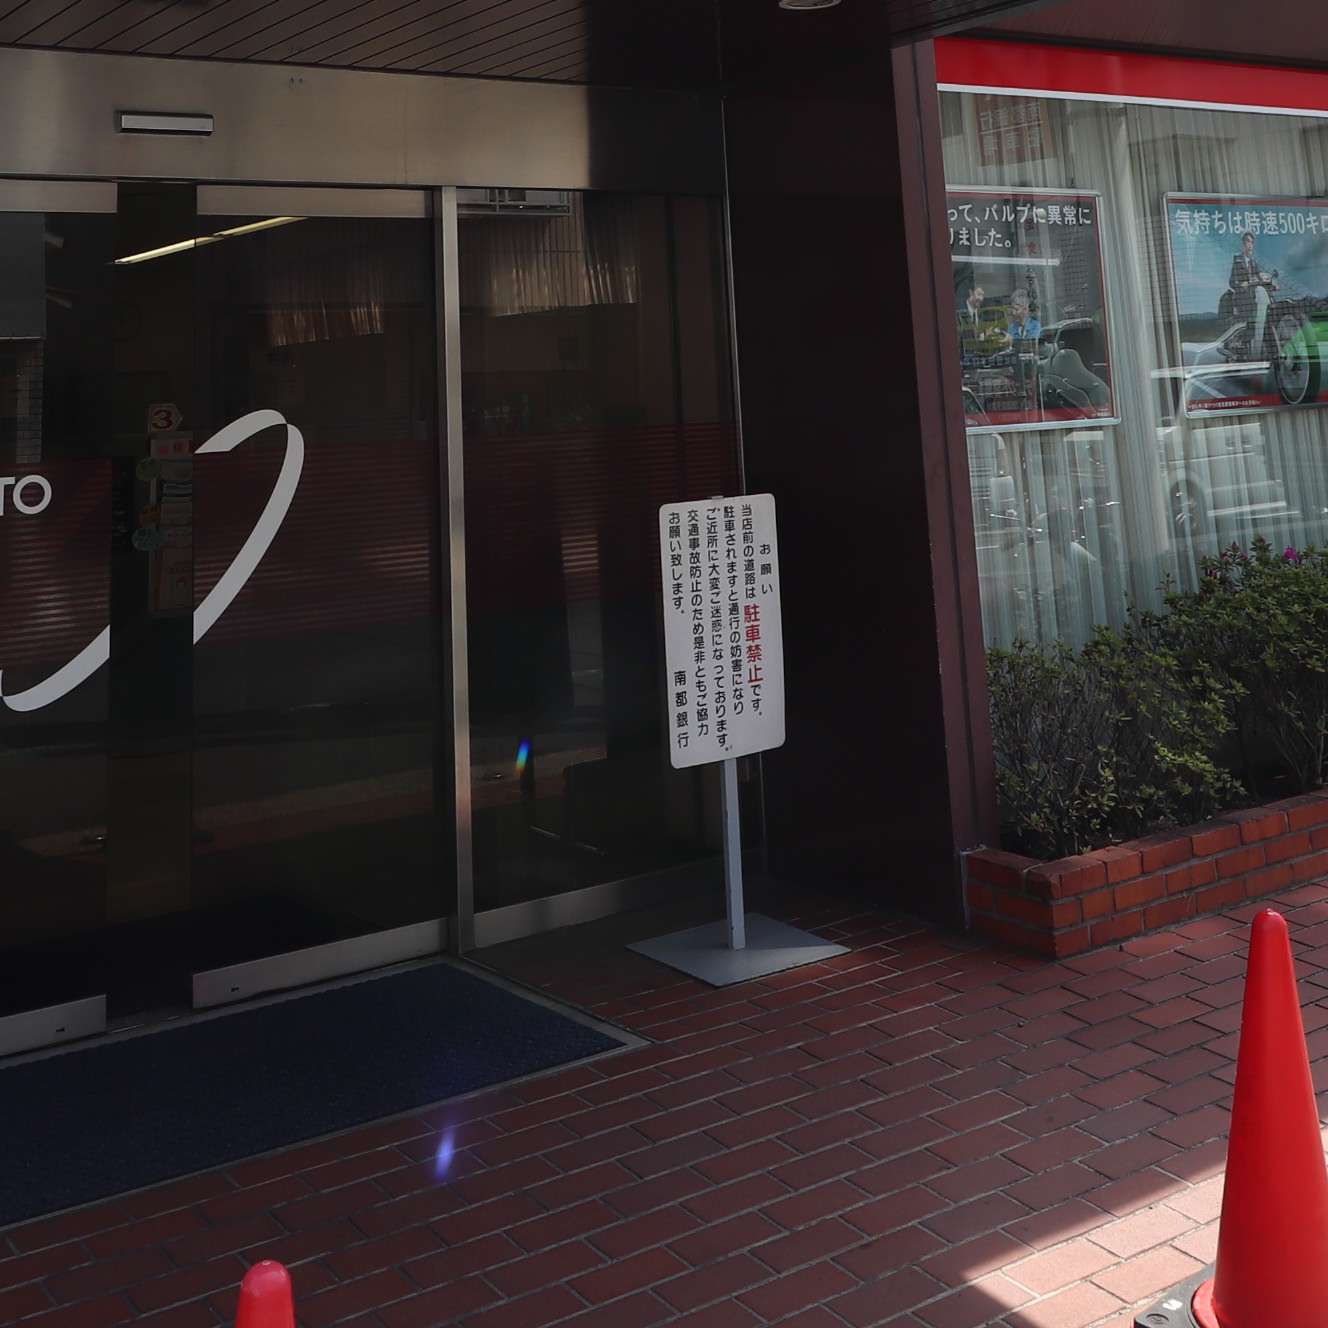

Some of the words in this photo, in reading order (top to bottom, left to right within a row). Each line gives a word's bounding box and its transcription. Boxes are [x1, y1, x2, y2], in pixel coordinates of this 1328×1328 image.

[151, 409, 174, 430] 3
[668, 512, 685, 615] お願い致します。
[723, 505, 744, 716] 駐車されますと通行の妨害になり
[759, 543, 774, 595] お願い
[687, 509, 709, 737] 交通事故防止のため是非ともご協力
[706, 507, 730, 752] ご近所に大変ご迷惑になっております。
[674, 670, 690, 749] 南都銀行
